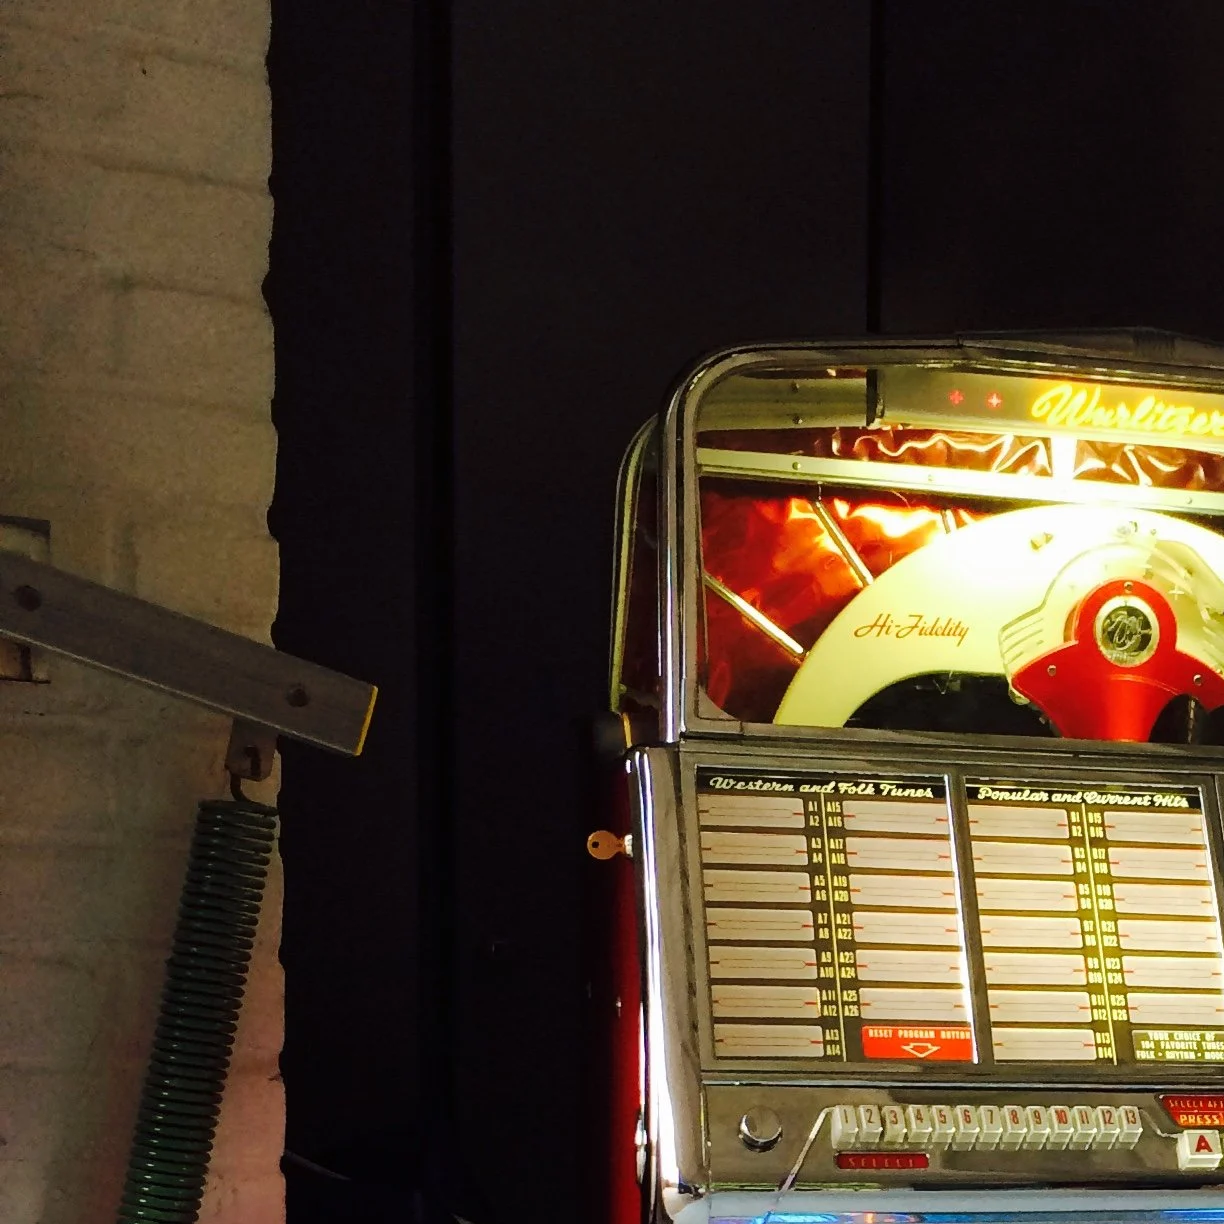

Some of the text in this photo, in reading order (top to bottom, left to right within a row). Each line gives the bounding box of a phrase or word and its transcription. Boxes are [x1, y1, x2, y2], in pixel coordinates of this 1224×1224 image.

[854, 613, 969, 647] Hi-Fidelity
[710, 777, 934, 799] Western and Folk Tunes
[977, 787, 1189, 808] Popular and Current Hits
[843, 1110, 849, 1124] 1
[865, 1110, 875, 1124] 2
[889, 1110, 898, 1125] 3
[915, 1109, 924, 1123] 4
[938, 1110, 947, 1124] 5
[963, 1109, 972, 1124] 6
[987, 1110, 995, 1124] 7
[1010, 1110, 1019, 1125] 8
[1033, 1109, 1042, 1125] 9
[1055, 1109, 1068, 1125] 10
[1080, 1110, 1090, 1125] 11
[1102, 1110, 1115, 1125] 12
[1124, 1110, 1137, 1124] 13
[1179, 1114, 1219, 1125] PRESS
[1195, 1134, 1213, 1153] A
